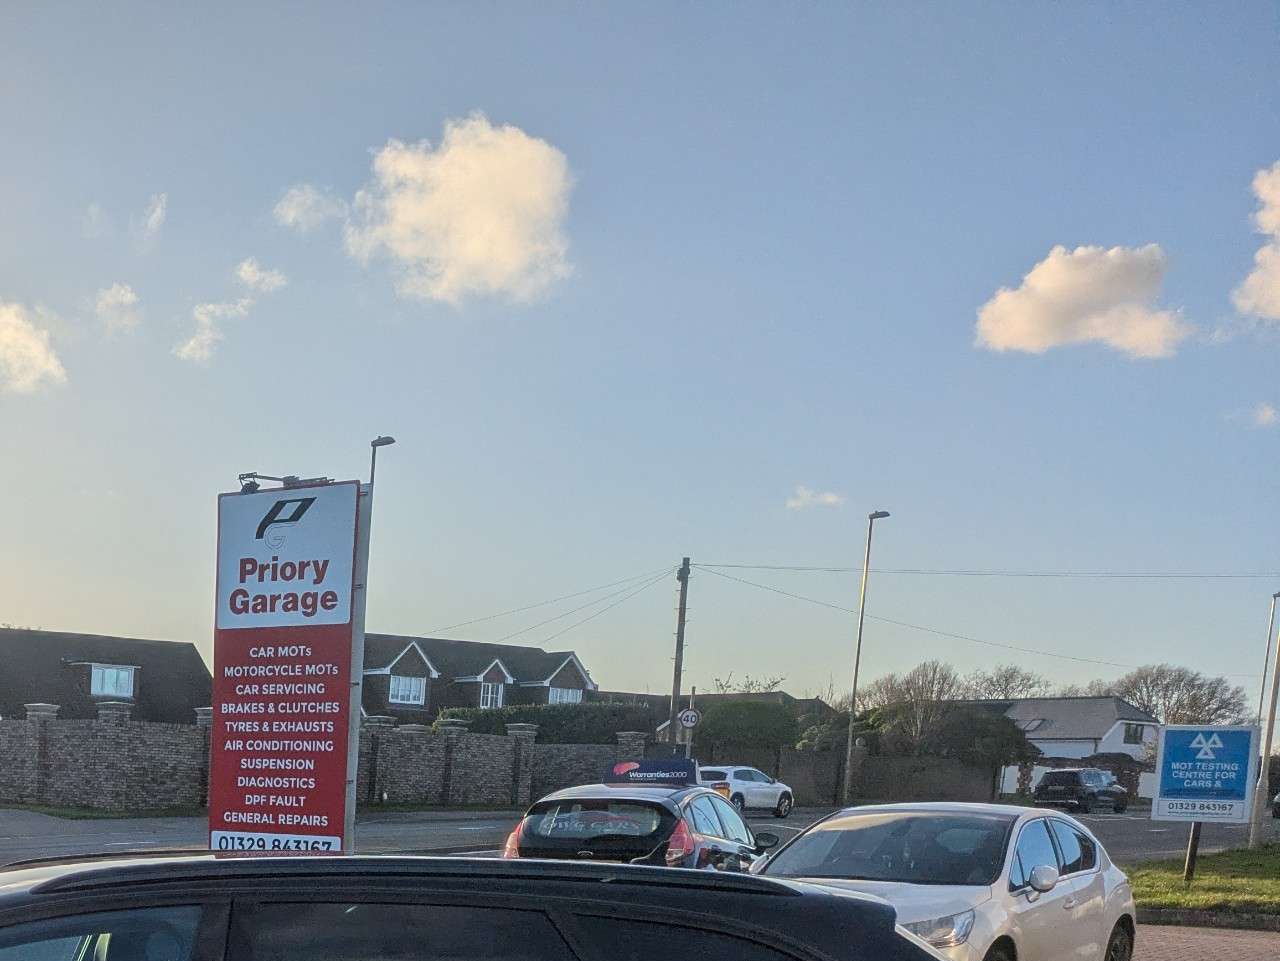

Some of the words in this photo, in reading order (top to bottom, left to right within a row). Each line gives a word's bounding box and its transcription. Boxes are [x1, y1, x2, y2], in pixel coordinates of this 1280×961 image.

[239, 556, 329, 584] Priory
[229, 588, 338, 617] Garage
[249, 647, 274, 658] CAR
[278, 646, 312, 657] MOTs
[224, 665, 302, 677] MOTORCYCLE
[305, 664, 339, 675] MOTs
[235, 685, 259, 695] CAR
[262, 684, 325, 694] SERVICING
[221, 703, 265, 714] BRAKES
[268, 703, 275, 713] &
[278, 702, 340, 713] CLUTCHES
[683, 714, 697, 724] 40
[225, 721, 259, 732] TYRES
[262, 722, 270, 732] &
[272, 721, 334, 732] EXHAUSTS
[224, 740, 243, 751] AIR
[246, 740, 334, 752] CONDITIONING
[240, 758, 314, 770] SUSPENSION
[1171, 762, 1193, 770] MOT
[1196, 762, 1239, 771] TESTING
[1172, 771, 1212, 780] CENTRE
[1215, 771, 1237, 780] FOR
[237, 776, 316, 789] DIAGNOSTICS
[1183, 779, 1211, 788] CARS
[245, 794, 266, 805] DPF
[270, 795, 306, 807] FAULT
[1168, 802, 1196, 810] 01329
[1199, 803, 1234, 811] 843167
[223, 811, 275, 823] GENERAL
[278, 813, 328, 826] REPAIRS
[218, 836, 266, 850] 01329
[272, 838, 332, 851] 843167
